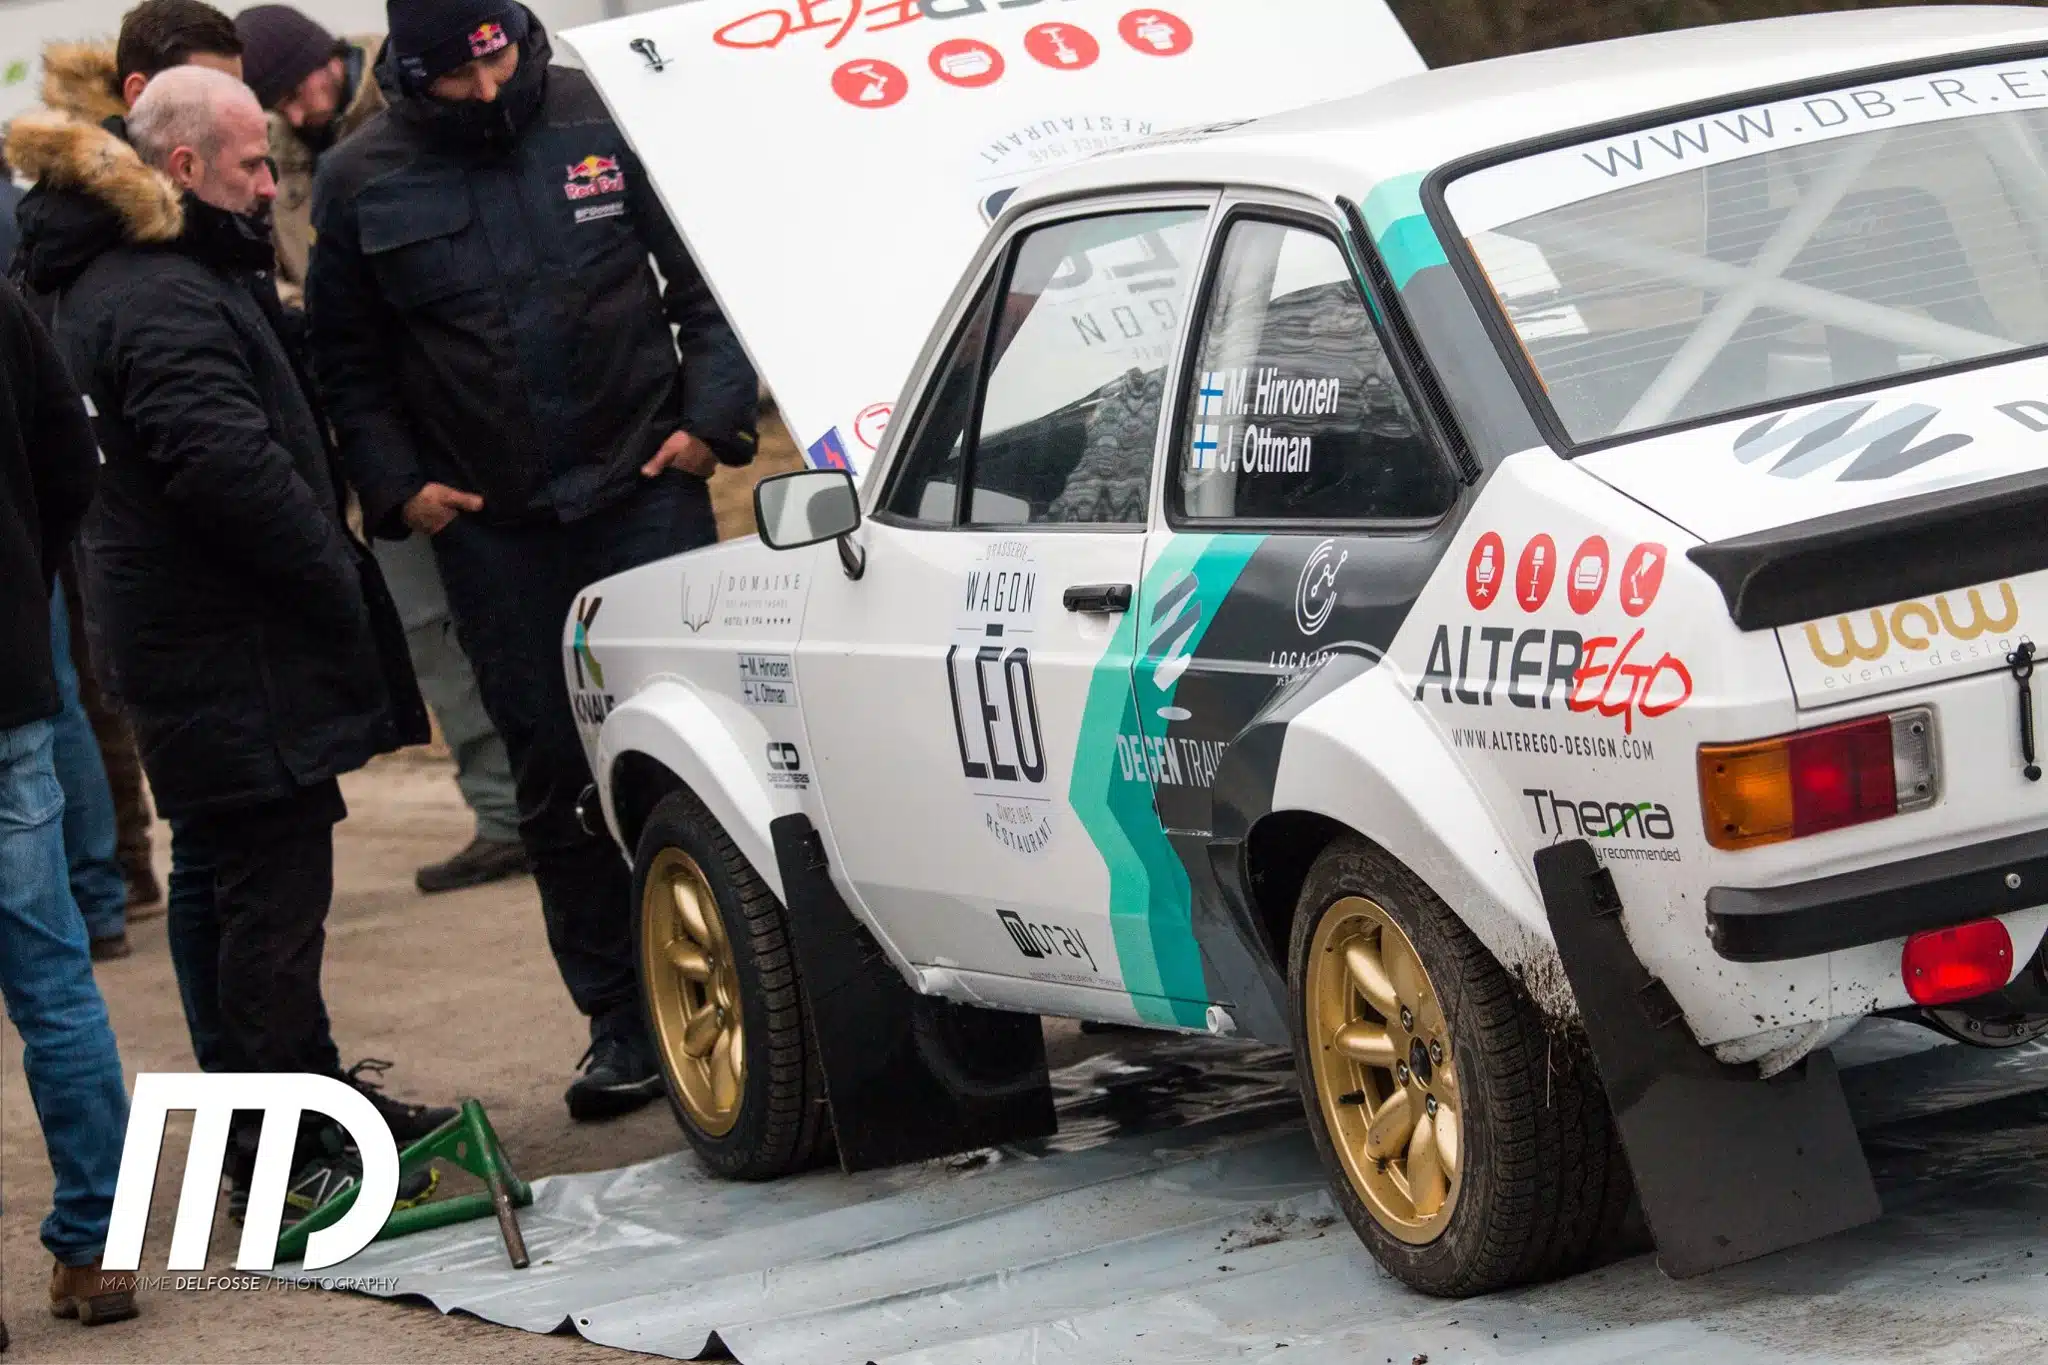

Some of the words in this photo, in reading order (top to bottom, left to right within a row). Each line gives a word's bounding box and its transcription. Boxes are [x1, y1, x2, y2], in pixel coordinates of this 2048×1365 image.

[980, 115, 1153, 165] RESTAURANT
[1583, 70, 2048, 178] WWW.DB-R.E
[1226, 367, 1248, 415] M.
[1254, 367, 1340, 415] Hirvonen
[1220, 425, 1236, 473] J.
[1242, 424, 1312, 474] Ottman
[987, 541, 1029, 561] BRASSERIE
[965, 571, 1036, 613] WAGON
[1823, 657, 1912, 689] event
[1117, 733, 1183, 785] DEGEN
[1452, 728, 1654, 760] WWW.ALTEREGO-DESIGN.COM
[986, 812, 1053, 854] RESTAURANT
[1523, 788, 1674, 840] Thema
[1602, 845, 1682, 862] recommended
